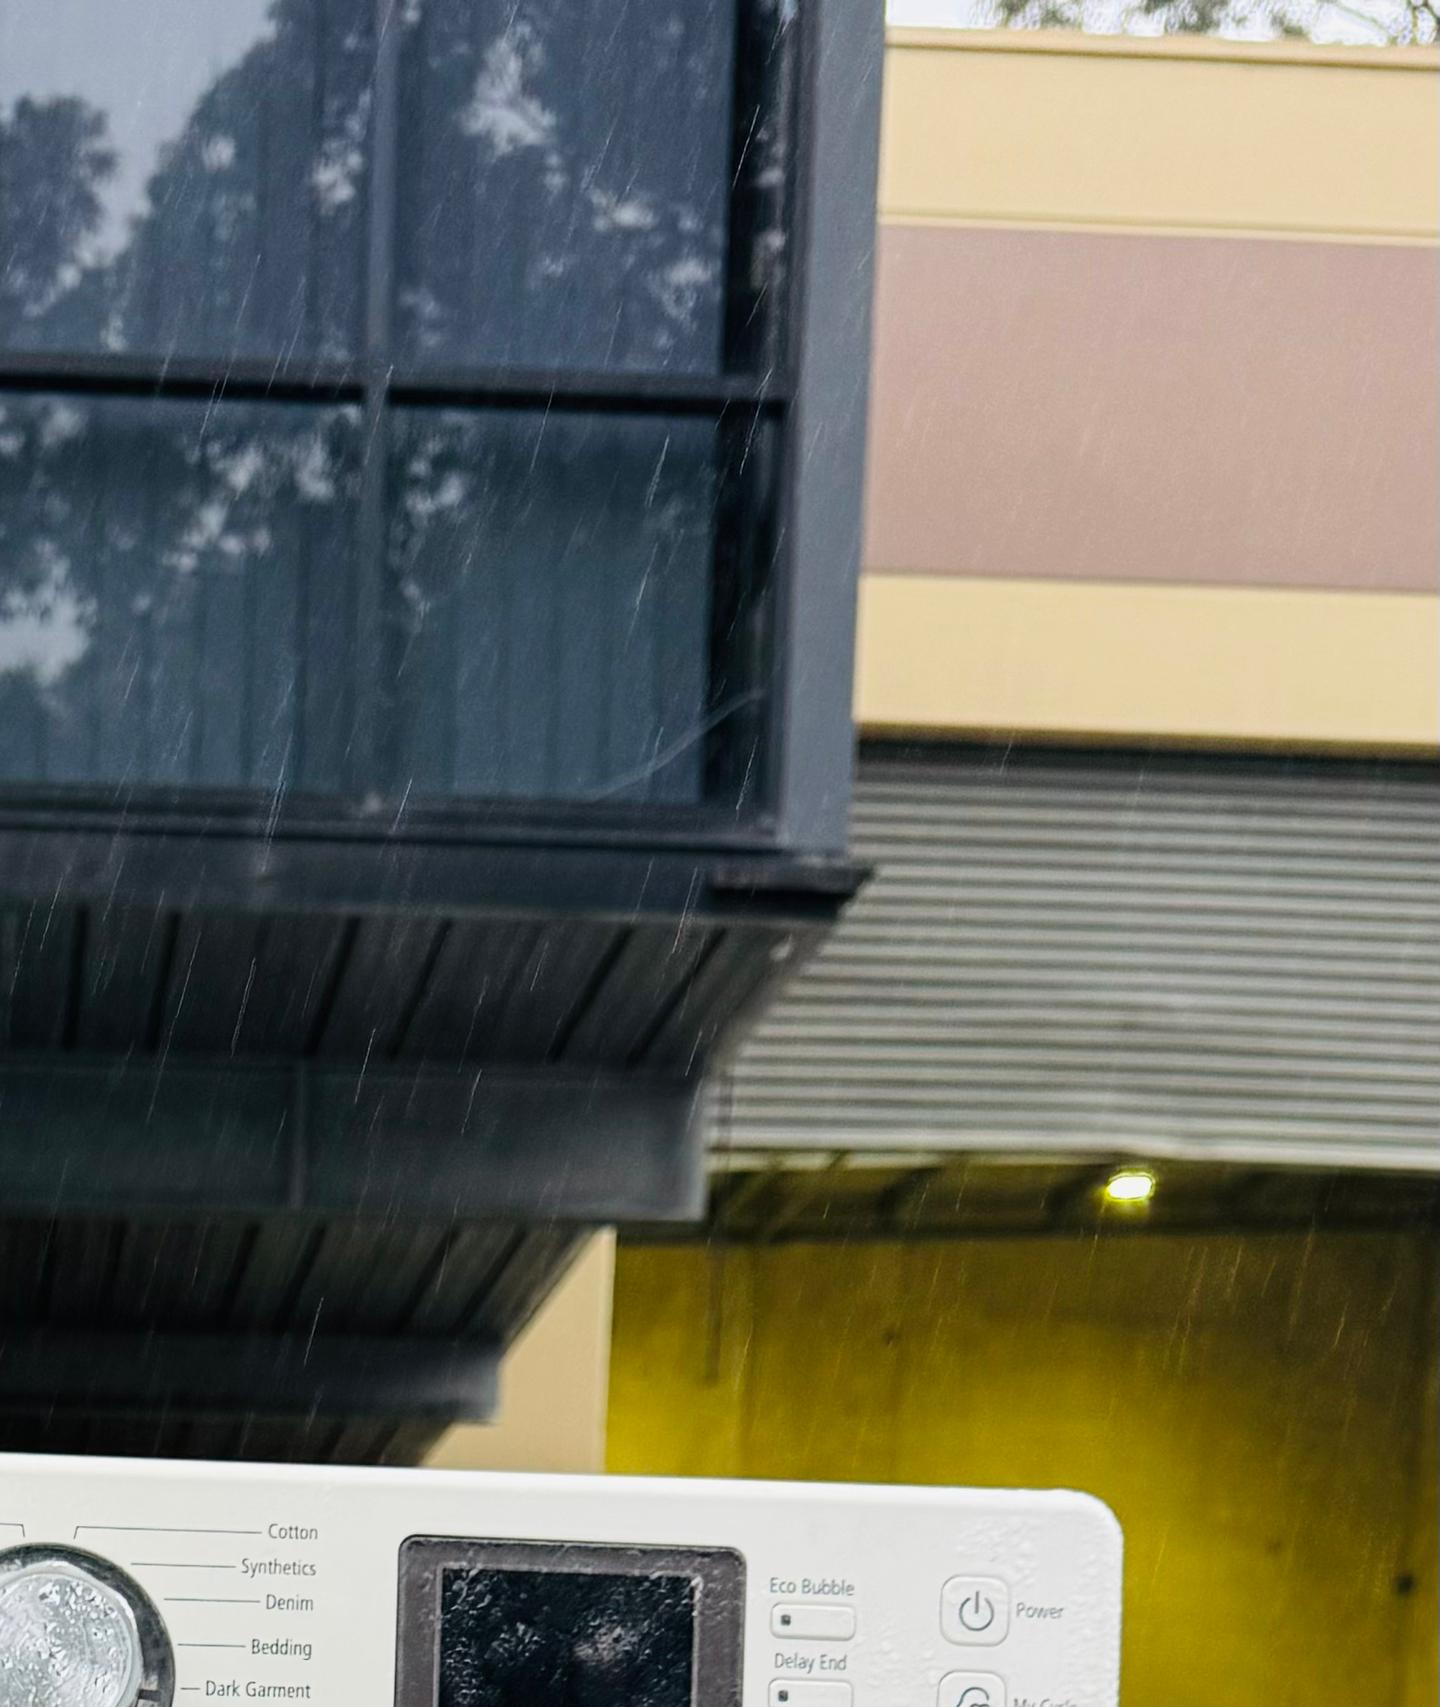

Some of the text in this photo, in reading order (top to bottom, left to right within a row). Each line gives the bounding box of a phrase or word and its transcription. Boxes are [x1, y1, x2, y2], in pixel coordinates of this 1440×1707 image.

[268, 1523, 318, 1540] Cotton
[241, 1558, 316, 1579] Synthetics
[770, 1577, 855, 1596] Eco Bubble
[266, 1594, 314, 1611] Denim
[1016, 1602, 1065, 1619] Power
[252, 1638, 312, 1661] Bedding
[774, 1652, 848, 1674] Delay End
[205, 1680, 311, 1699] Dark Garment
